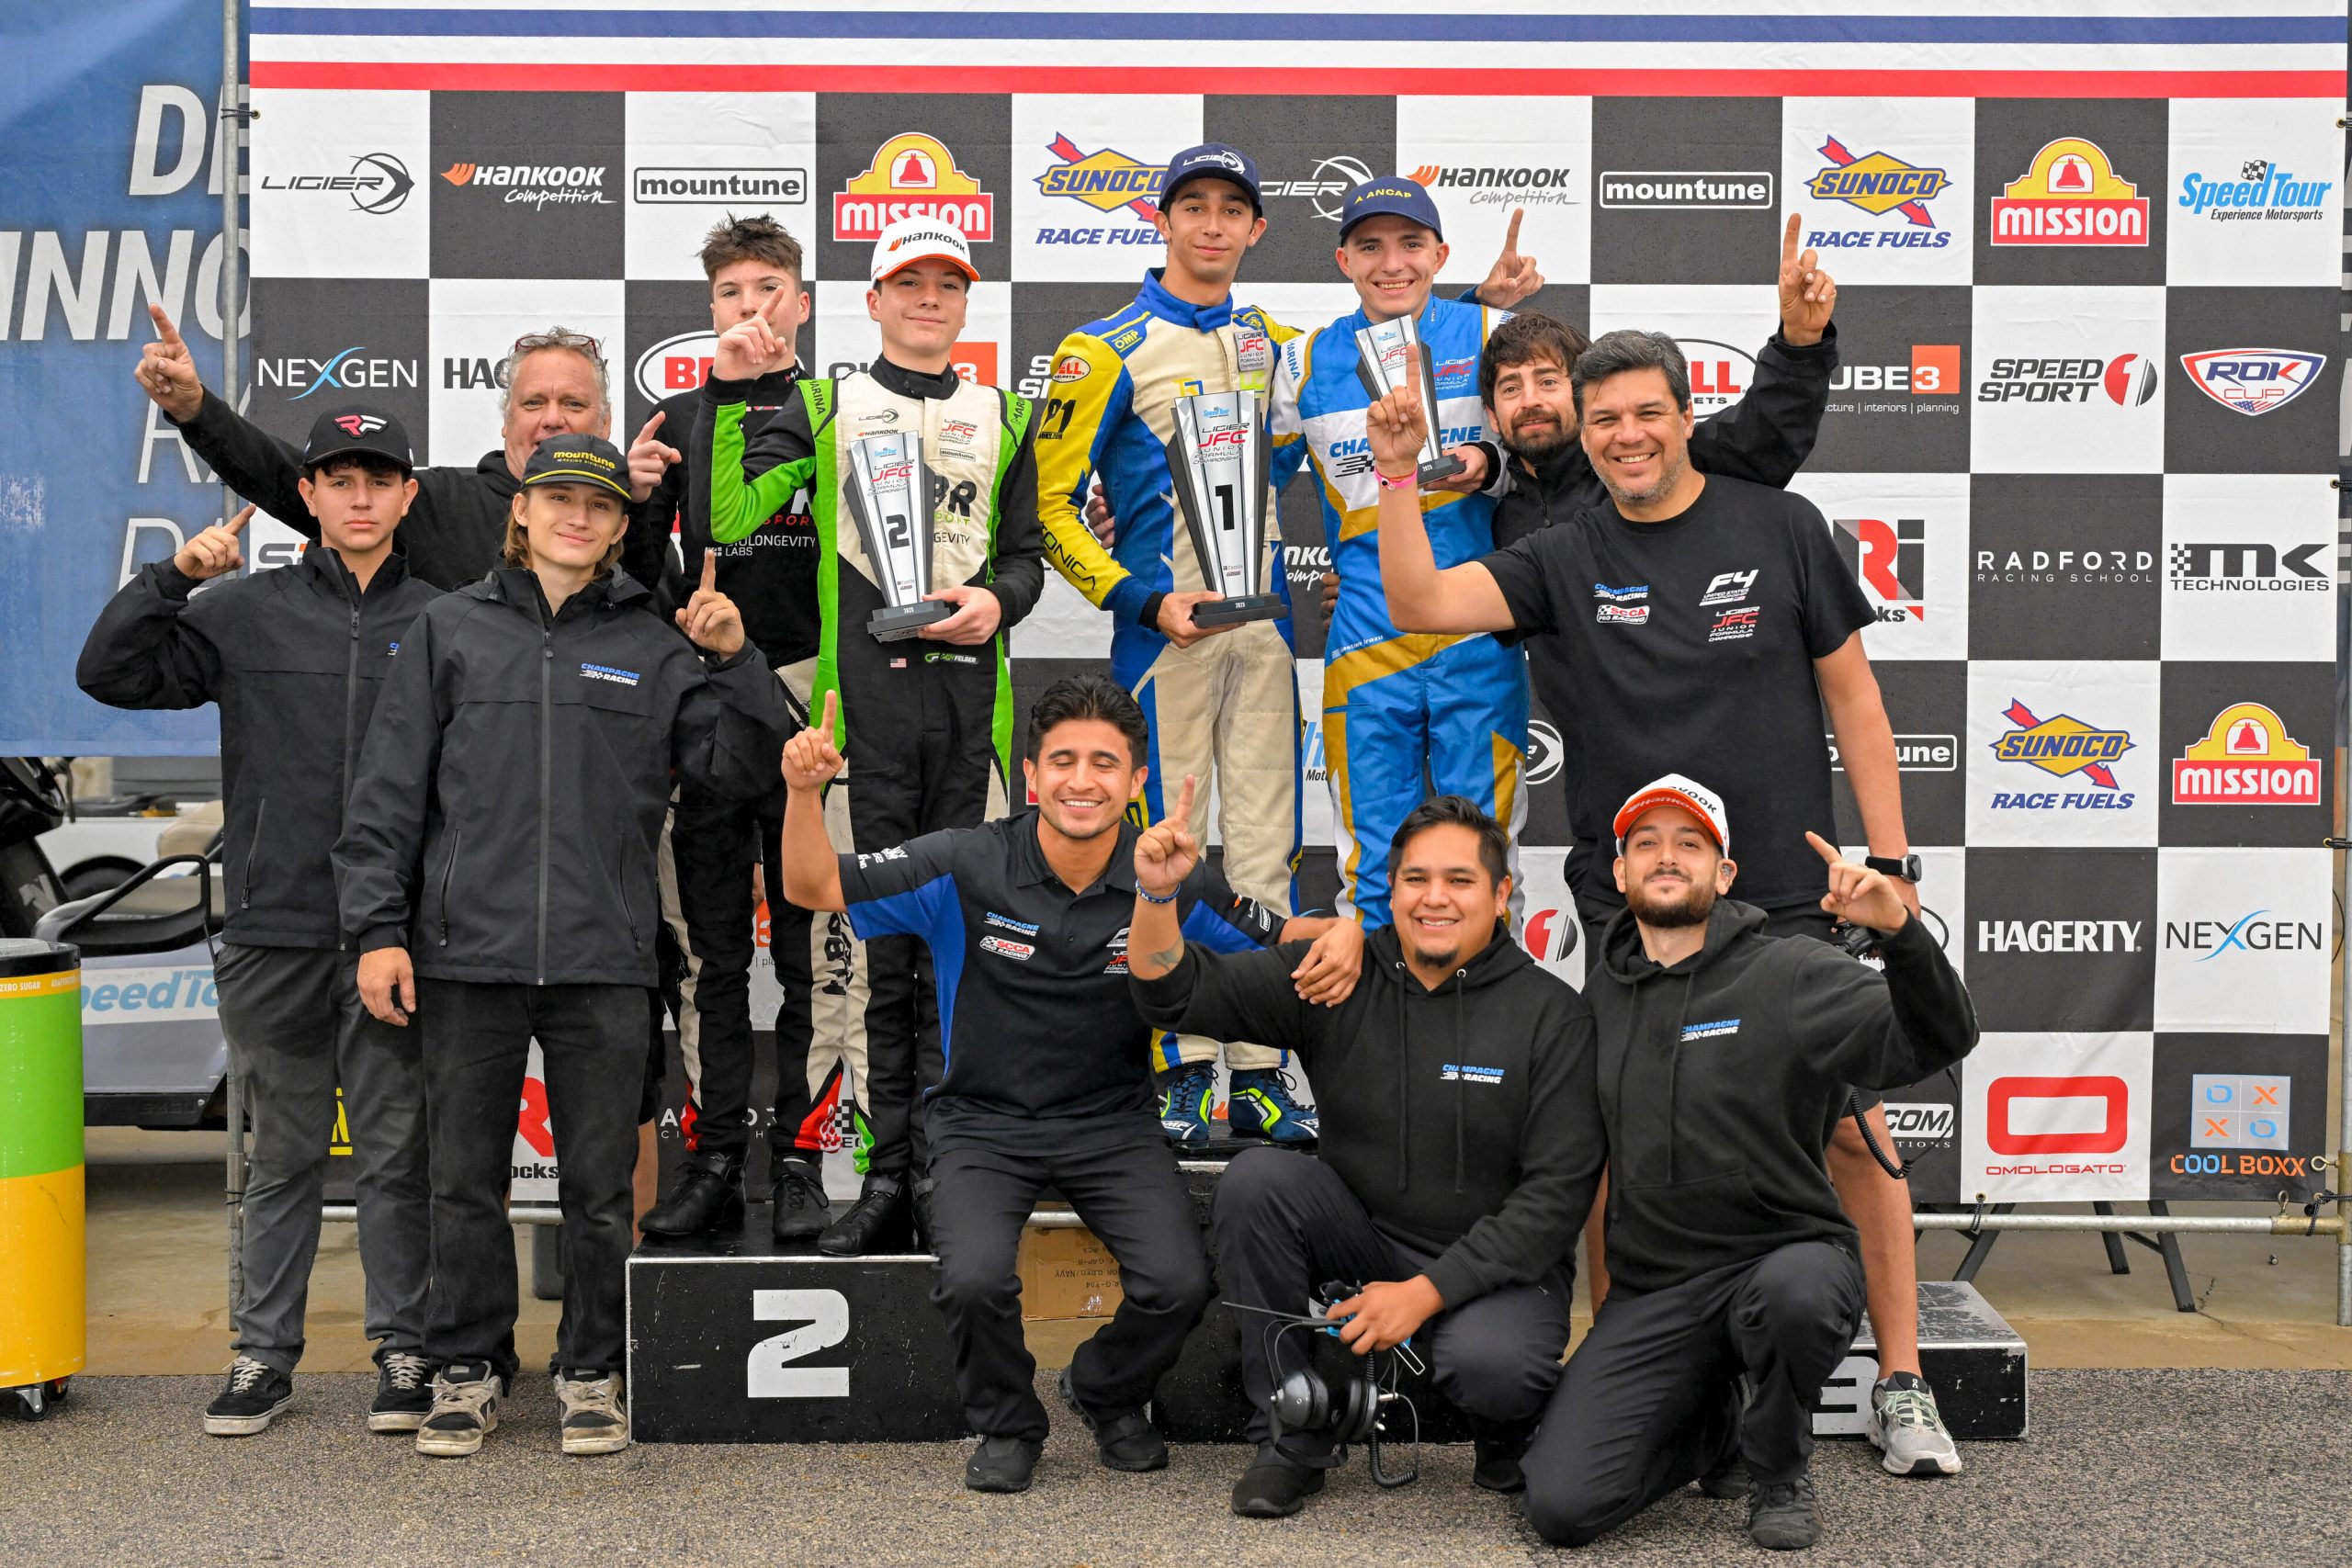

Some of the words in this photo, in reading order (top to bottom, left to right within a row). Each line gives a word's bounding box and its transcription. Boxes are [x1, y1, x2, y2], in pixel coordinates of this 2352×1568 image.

[1183, 154, 1237, 166] LIGIER
[261, 175, 386, 190] LIGIER
[640, 175, 800, 196] mountune
[1260, 181, 1348, 196] GIER
[1606, 179, 1766, 201] mountune
[1817, 171, 1939, 195] SUNOCO
[504, 188, 616, 210] Competition
[1366, 188, 1411, 199] ANCAP
[1470, 189, 1580, 211] Competition
[1999, 208, 2141, 236] MISSION
[2211, 209, 2262, 221] Experience
[2265, 209, 2323, 222] Motorsports
[1035, 229, 1104, 244] RACE
[1107, 229, 1168, 245] FUEL
[1805, 231, 1873, 248] RACE
[1877, 231, 1951, 248] FUELS
[1114, 331, 1138, 348] OMP
[1238, 332, 1262, 340] LIGIER
[1240, 339, 1264, 353] JFC
[1436, 355, 1476, 366] LIGIER
[258, 354, 417, 394] NEXGEN
[1990, 359, 2103, 378] SPEED
[2205, 361, 2301, 380] ROK
[1828, 366, 1940, 390] UBE3
[1978, 382, 2098, 402] SPORT
[2223, 388, 2285, 399] CUP
[1864, 402, 1907, 412] interiors
[1917, 402, 1960, 414] planning
[941, 423, 977, 437] JFC
[1202, 423, 1250, 434] LIGIER
[1197, 430, 1248, 446] JFC
[553, 451, 616, 469] mountune
[874, 459, 915, 470] LIGIER
[872, 466, 913, 482] JFC
[1216, 484, 1234, 531] 1
[885, 513, 910, 549] 2
[726, 547, 752, 556] LABS
[1978, 551, 2153, 570] RADFORD
[1705, 570, 1759, 593] F4
[1978, 574, 2054, 582] RACING
[2071, 574, 2153, 582] SCHOOL
[2170, 579, 2330, 592] TECHNOLOGIES
[1595, 583, 1648, 595] CHAMPAGNE
[1615, 592, 1647, 602] RACING
[1611, 607, 1645, 617] SCCA
[1715, 606, 1760, 616] LIGIER
[1611, 615, 1645, 623] RACING
[1713, 612, 1758, 628] JFC
[1709, 629, 1753, 637] FORMULA
[1711, 624, 1755, 633] JUNIOR
[1708, 633, 1753, 642] CHAMPIONSHIP
[581, 663, 640, 680] CHAMPAGNE
[603, 674, 638, 686] RACING
[2004, 734, 2122, 757] SUNOCO
[2179, 768, 2314, 795] MISSION
[1991, 794, 2062, 809] RACE
[2063, 794, 2135, 809] FUELS
[986, 911, 1039, 931] CHAMPAGNE
[1005, 924, 1036, 936] RACING
[1979, 920, 2142, 952] HAGERTY
[2165, 917, 2323, 955] NEXGEN
[997, 941, 1030, 953] SCCA
[998, 948, 1028, 958] RACING
[19, 981, 41, 991] SUGAR
[1702, 1026, 1738, 1037] RACING
[1442, 1064, 1504, 1076] CHAMPAGNE
[1464, 1074, 1501, 1084] RACING
[1986, 1164, 2124, 1176] OMOLOGATO
[2171, 1154, 2234, 1175] COOL
[2240, 1155, 2307, 1178] BOXX
[748, 1290, 849, 1397] 2
